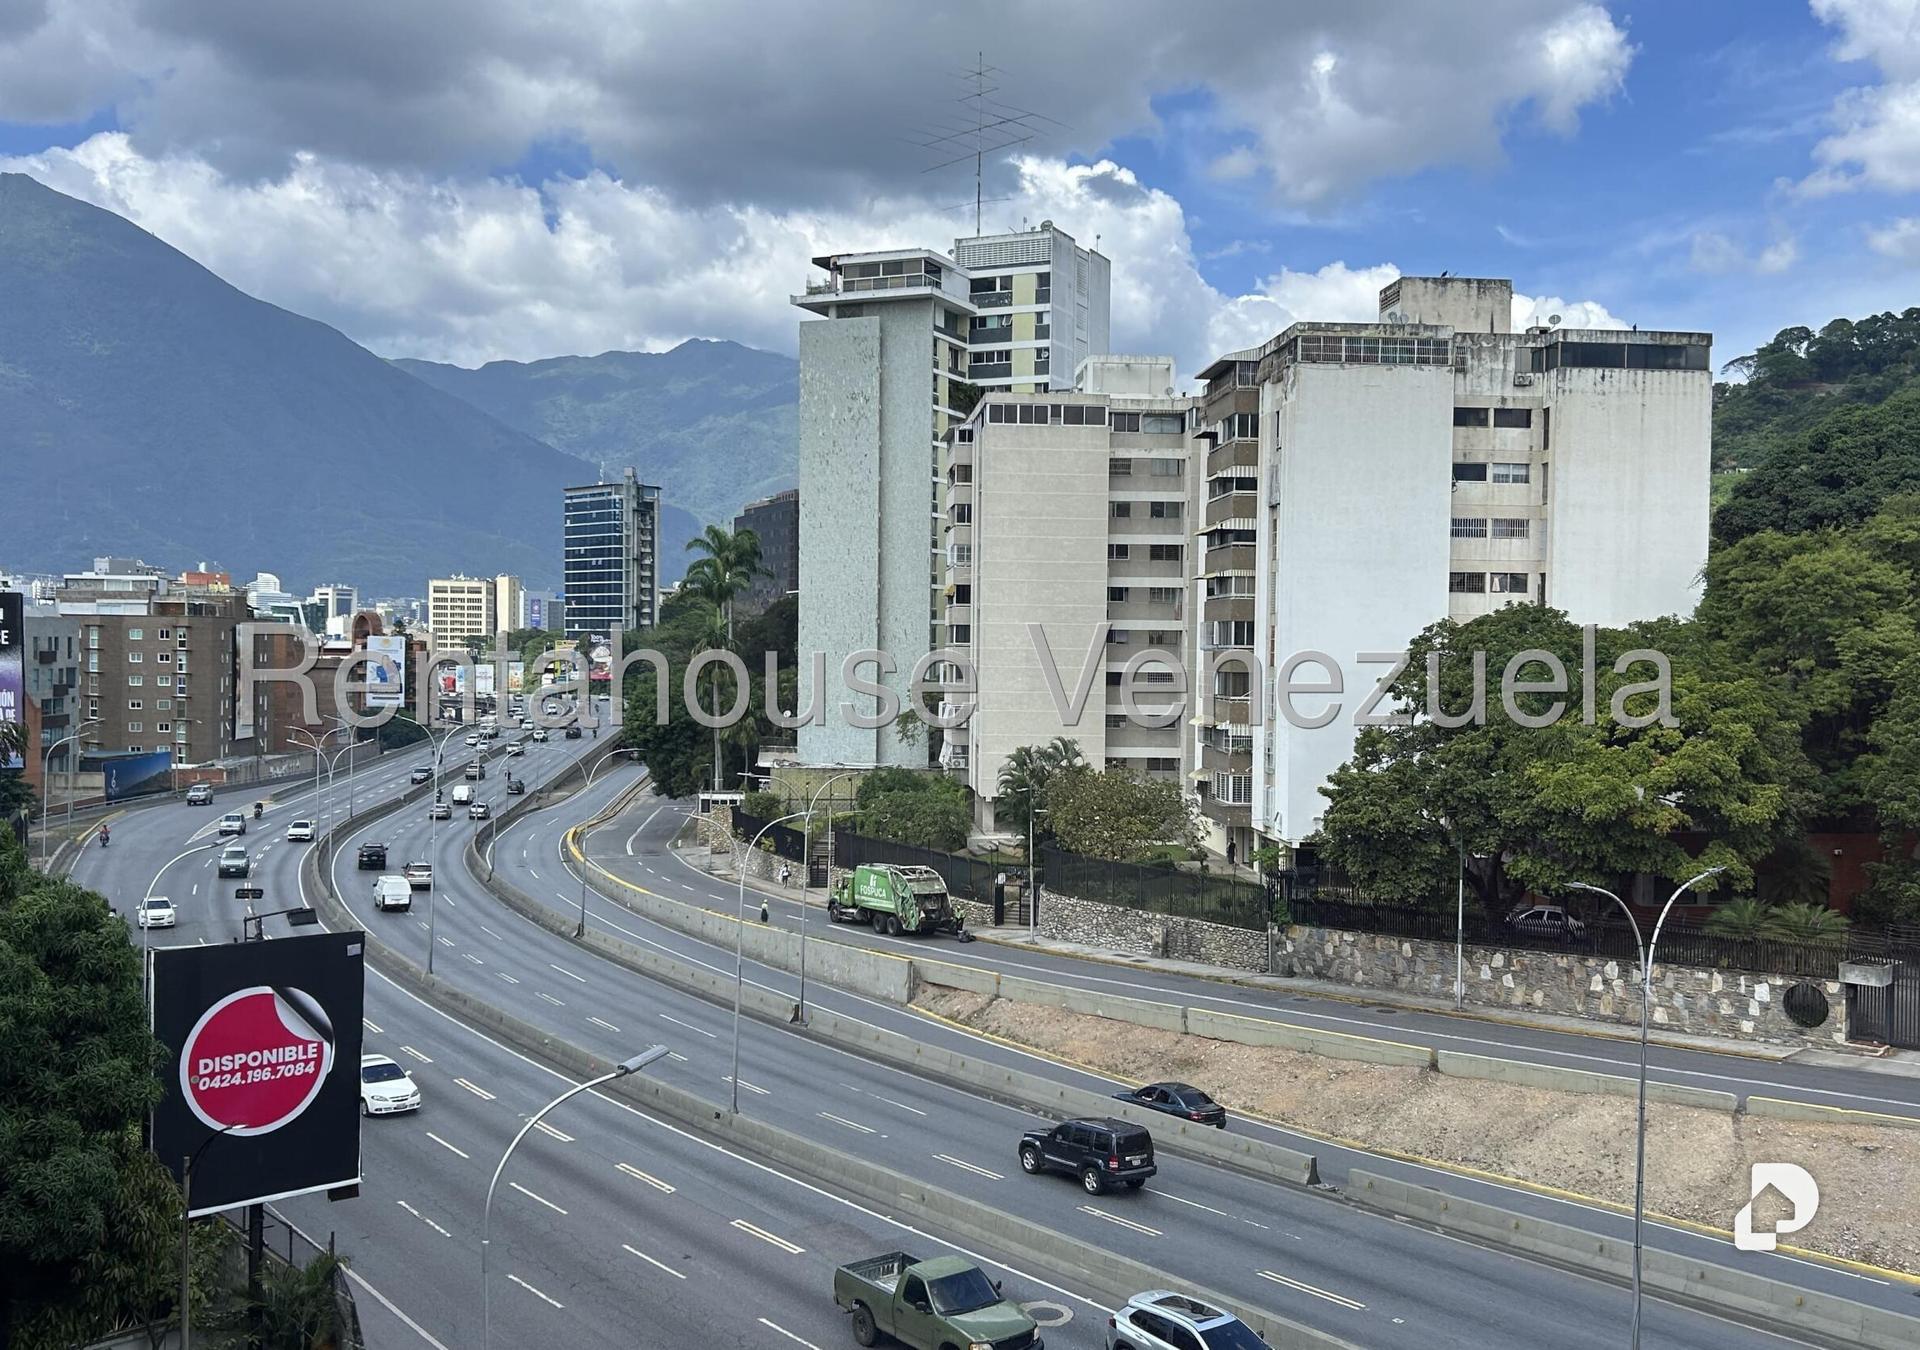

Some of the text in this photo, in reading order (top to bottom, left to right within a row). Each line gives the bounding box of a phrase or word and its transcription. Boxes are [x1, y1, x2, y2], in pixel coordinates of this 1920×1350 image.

[860, 884, 886, 898] FOSPUCA
[198, 1042, 318, 1076] DISPONIBLE
[198, 1060, 316, 1091] 0424.196.7084
